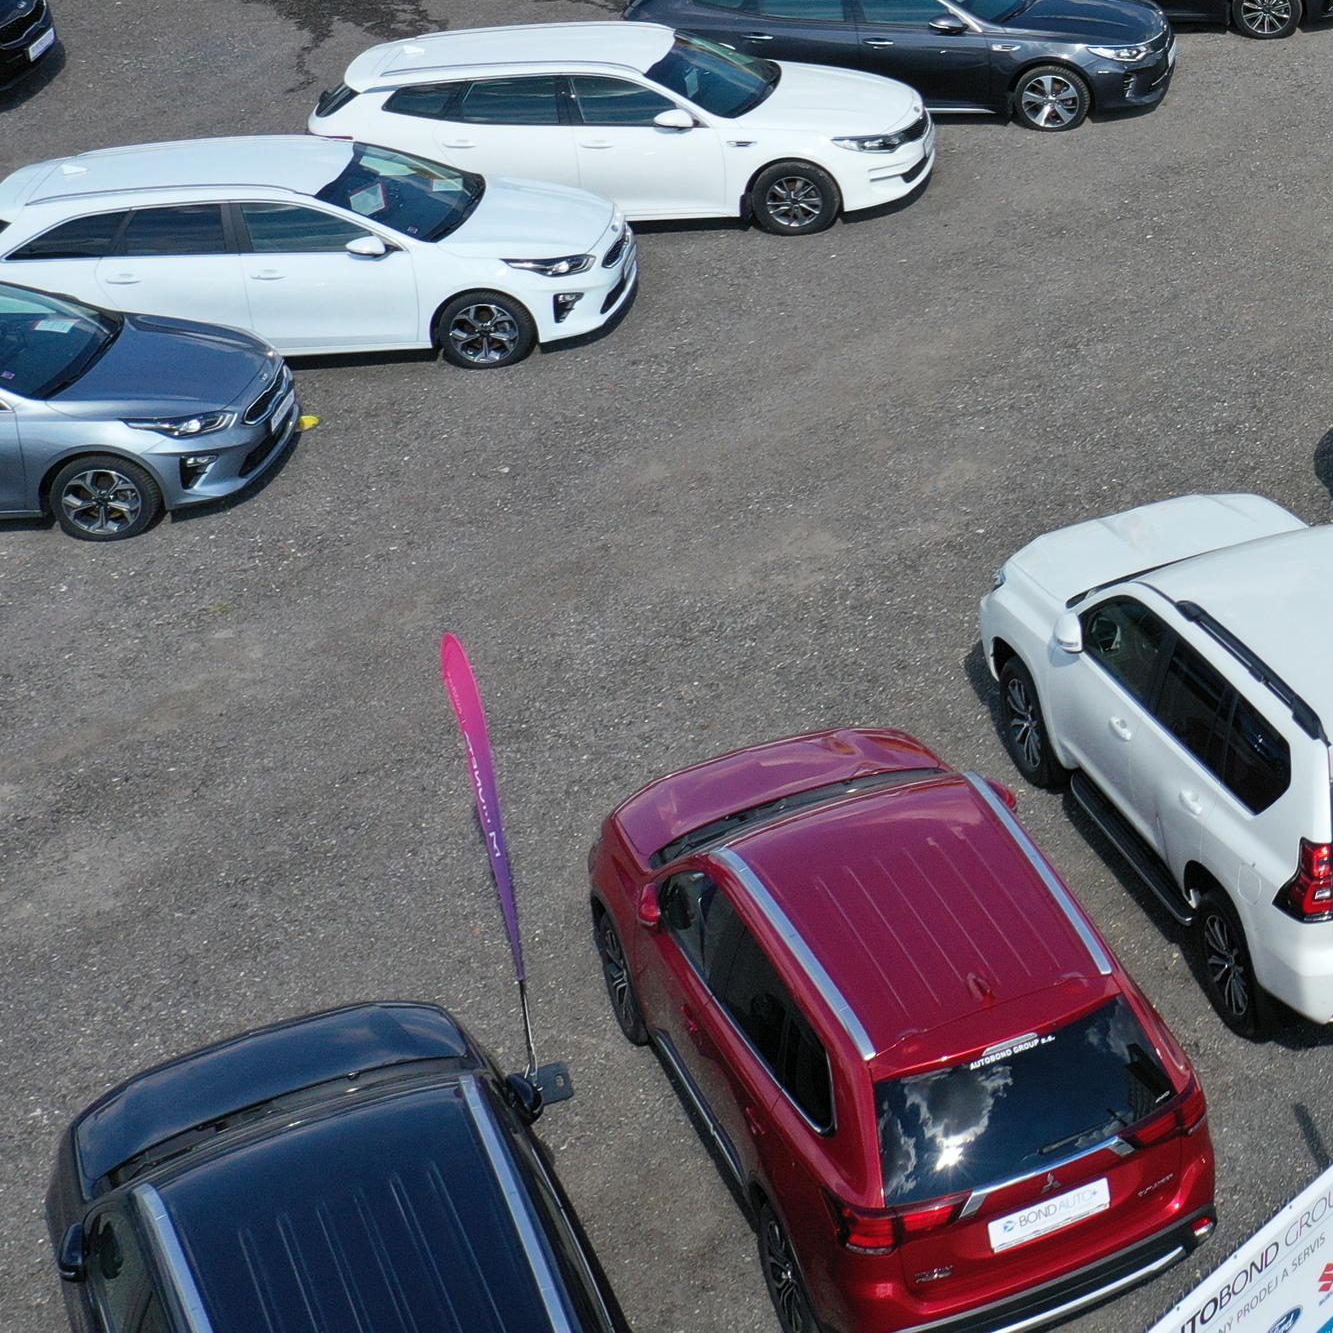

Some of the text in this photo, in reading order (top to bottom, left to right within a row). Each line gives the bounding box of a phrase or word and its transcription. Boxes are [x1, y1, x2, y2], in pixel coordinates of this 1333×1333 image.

[1236, 1277, 1279, 1324] PRODEJ
[1280, 1269, 1289, 1283] A
[1292, 1234, 1326, 1273] SERVIS
